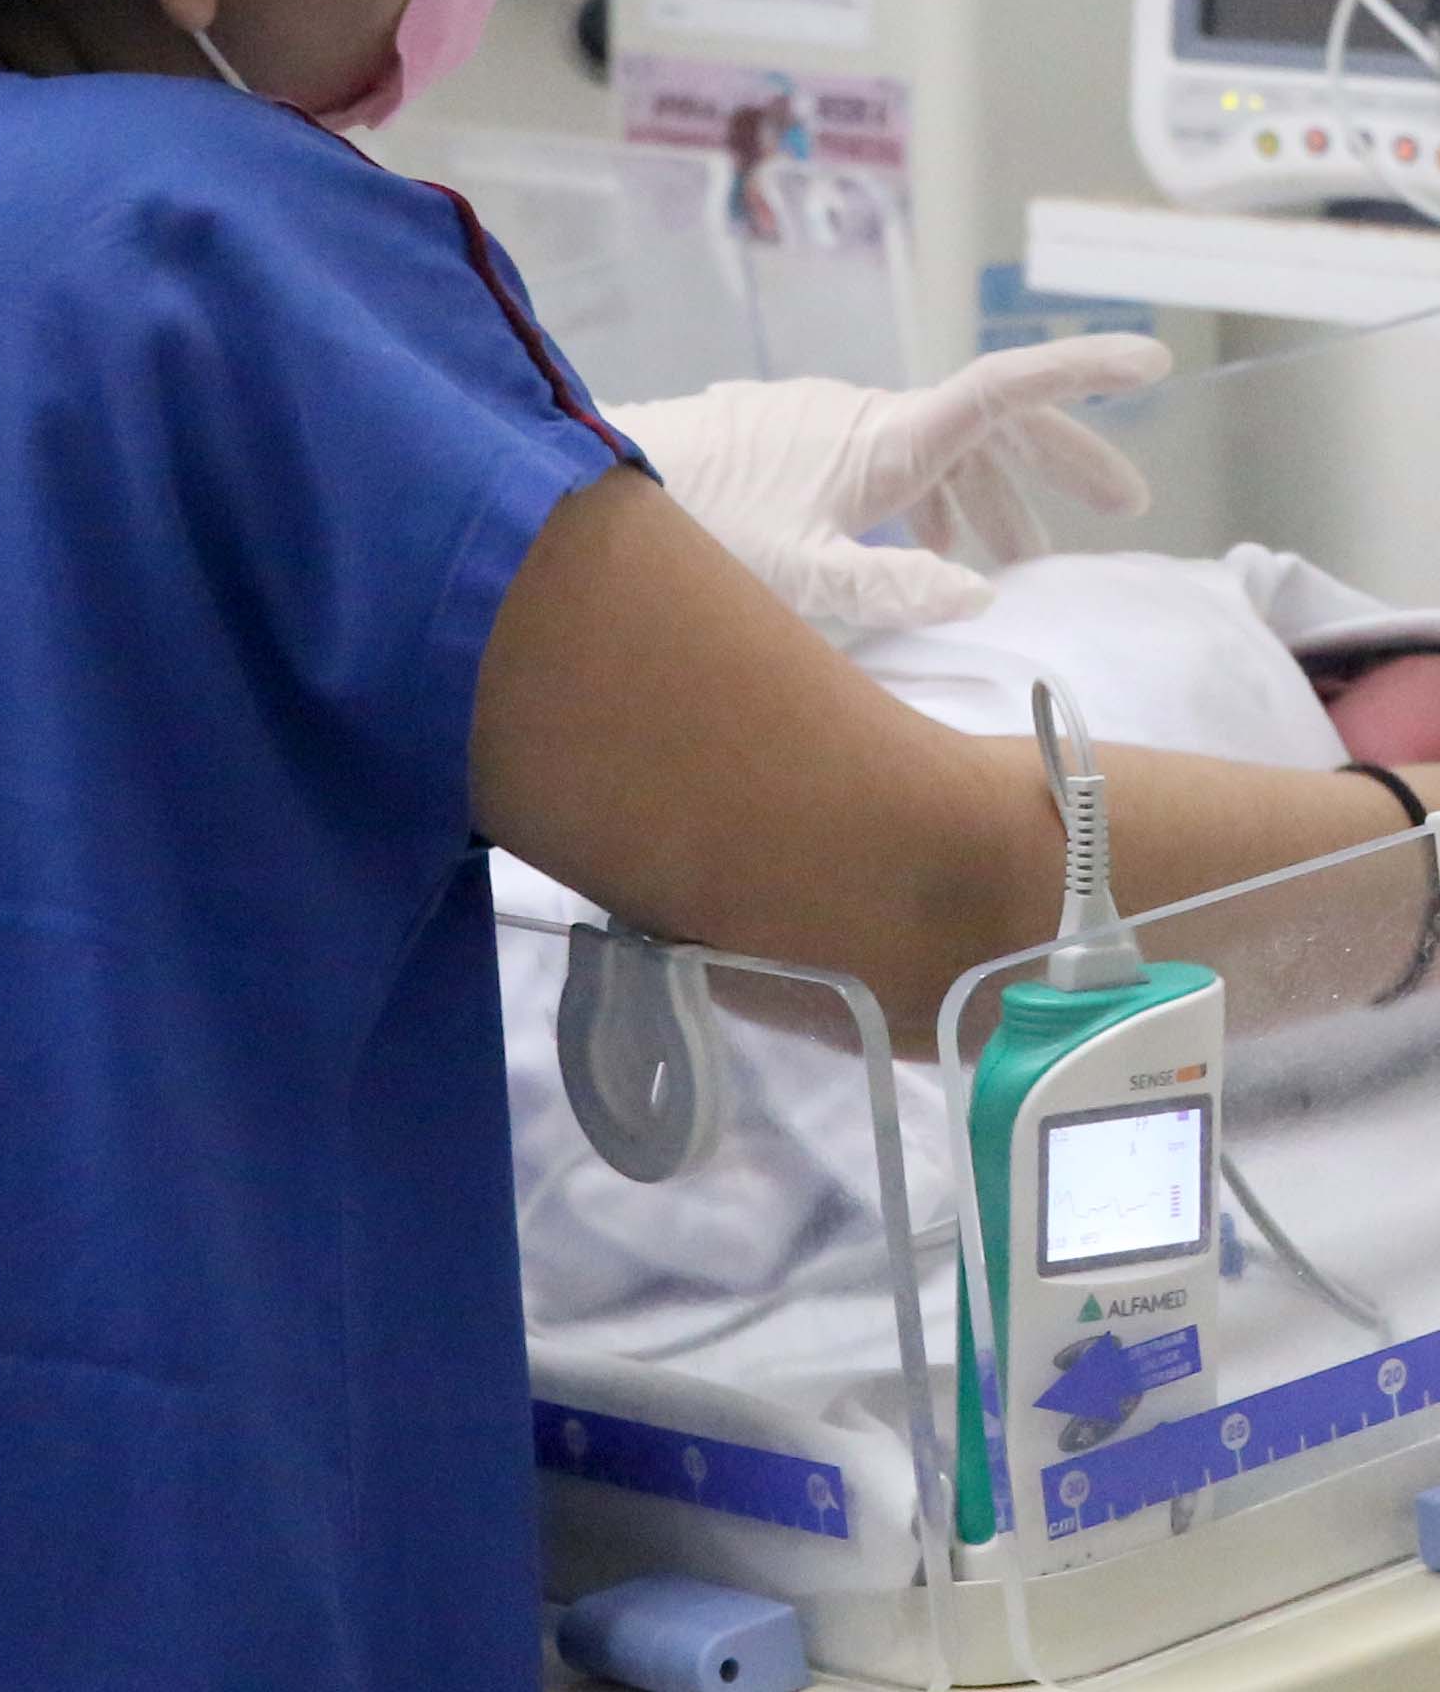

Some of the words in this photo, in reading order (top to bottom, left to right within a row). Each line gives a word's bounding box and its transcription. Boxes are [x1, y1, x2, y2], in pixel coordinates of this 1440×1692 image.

[1107, 1289, 1188, 1319] ALFAMED
[1384, 1365, 1403, 1388] 20
[1226, 1419, 1246, 1443] 25
